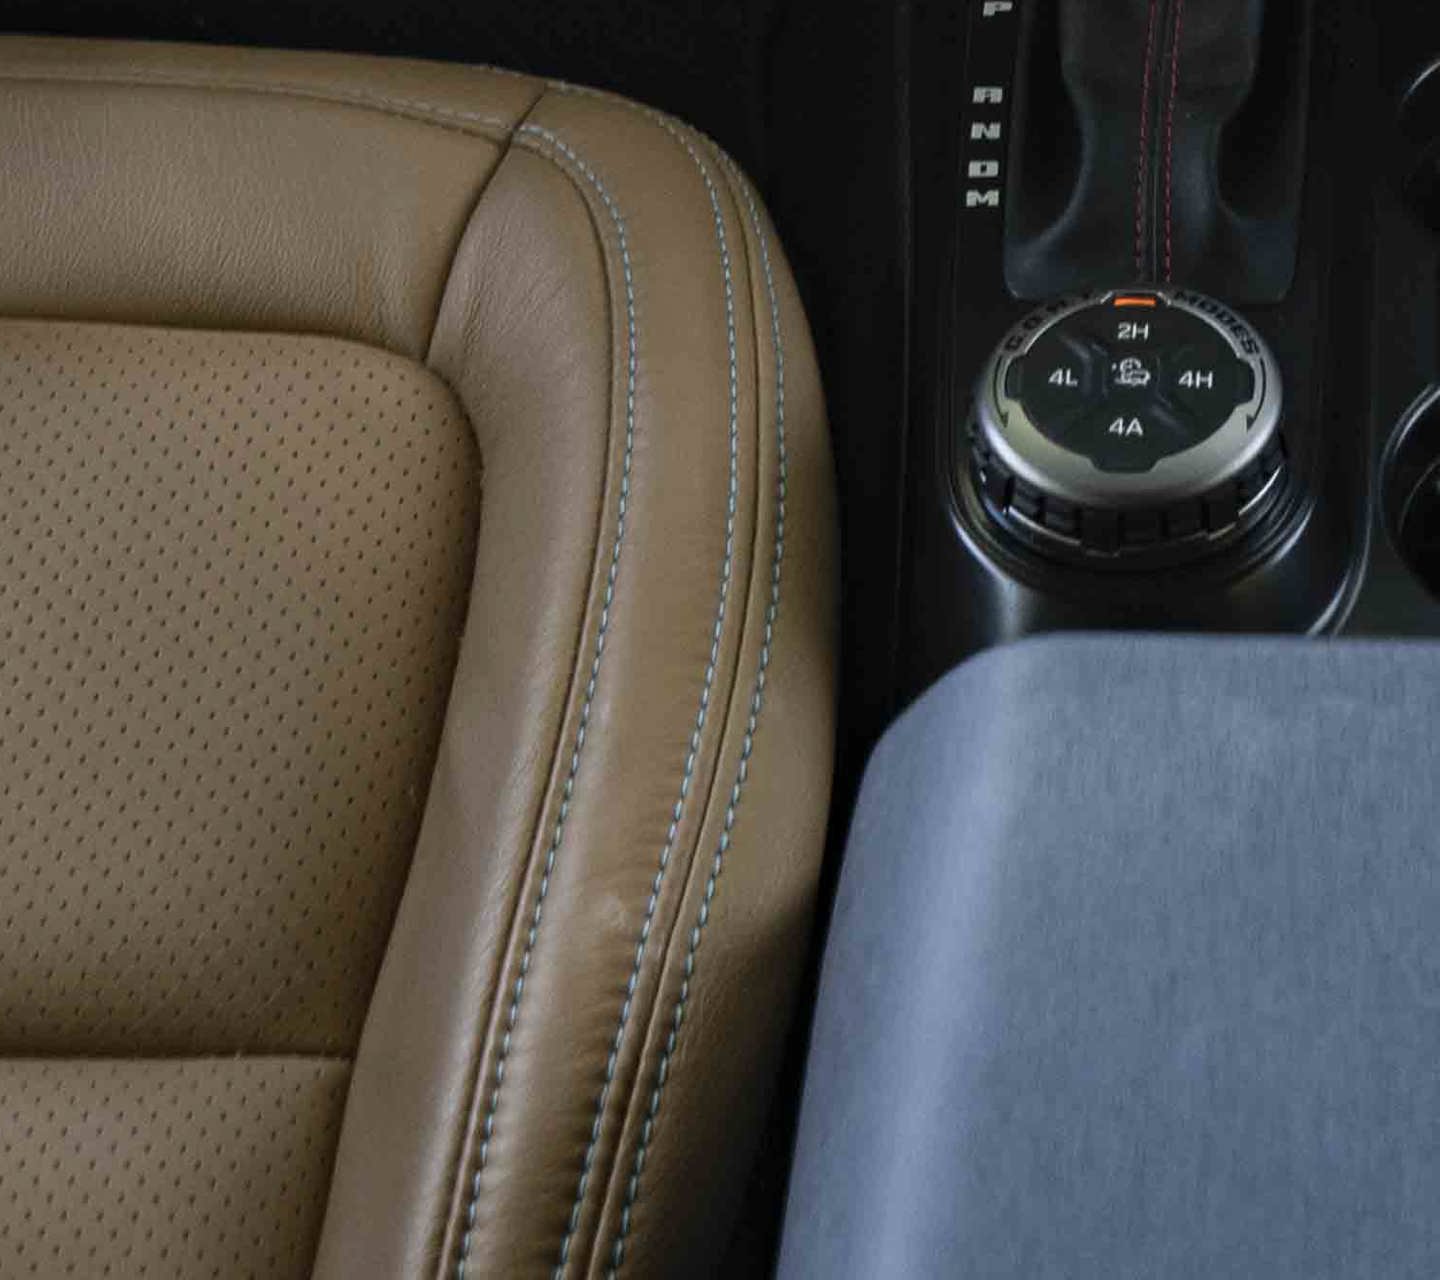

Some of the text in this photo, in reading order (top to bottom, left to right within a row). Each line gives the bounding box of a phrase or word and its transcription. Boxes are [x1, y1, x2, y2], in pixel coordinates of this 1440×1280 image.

[982, 0, 1013, 17] P
[970, 122, 1001, 140] N
[968, 160, 999, 178] D
[966, 189, 1000, 207] M
[1117, 321, 1149, 340] 2H
[1048, 367, 1078, 387] 4L
[1178, 369, 1213, 389] 4H
[1109, 416, 1144, 436] 4A
